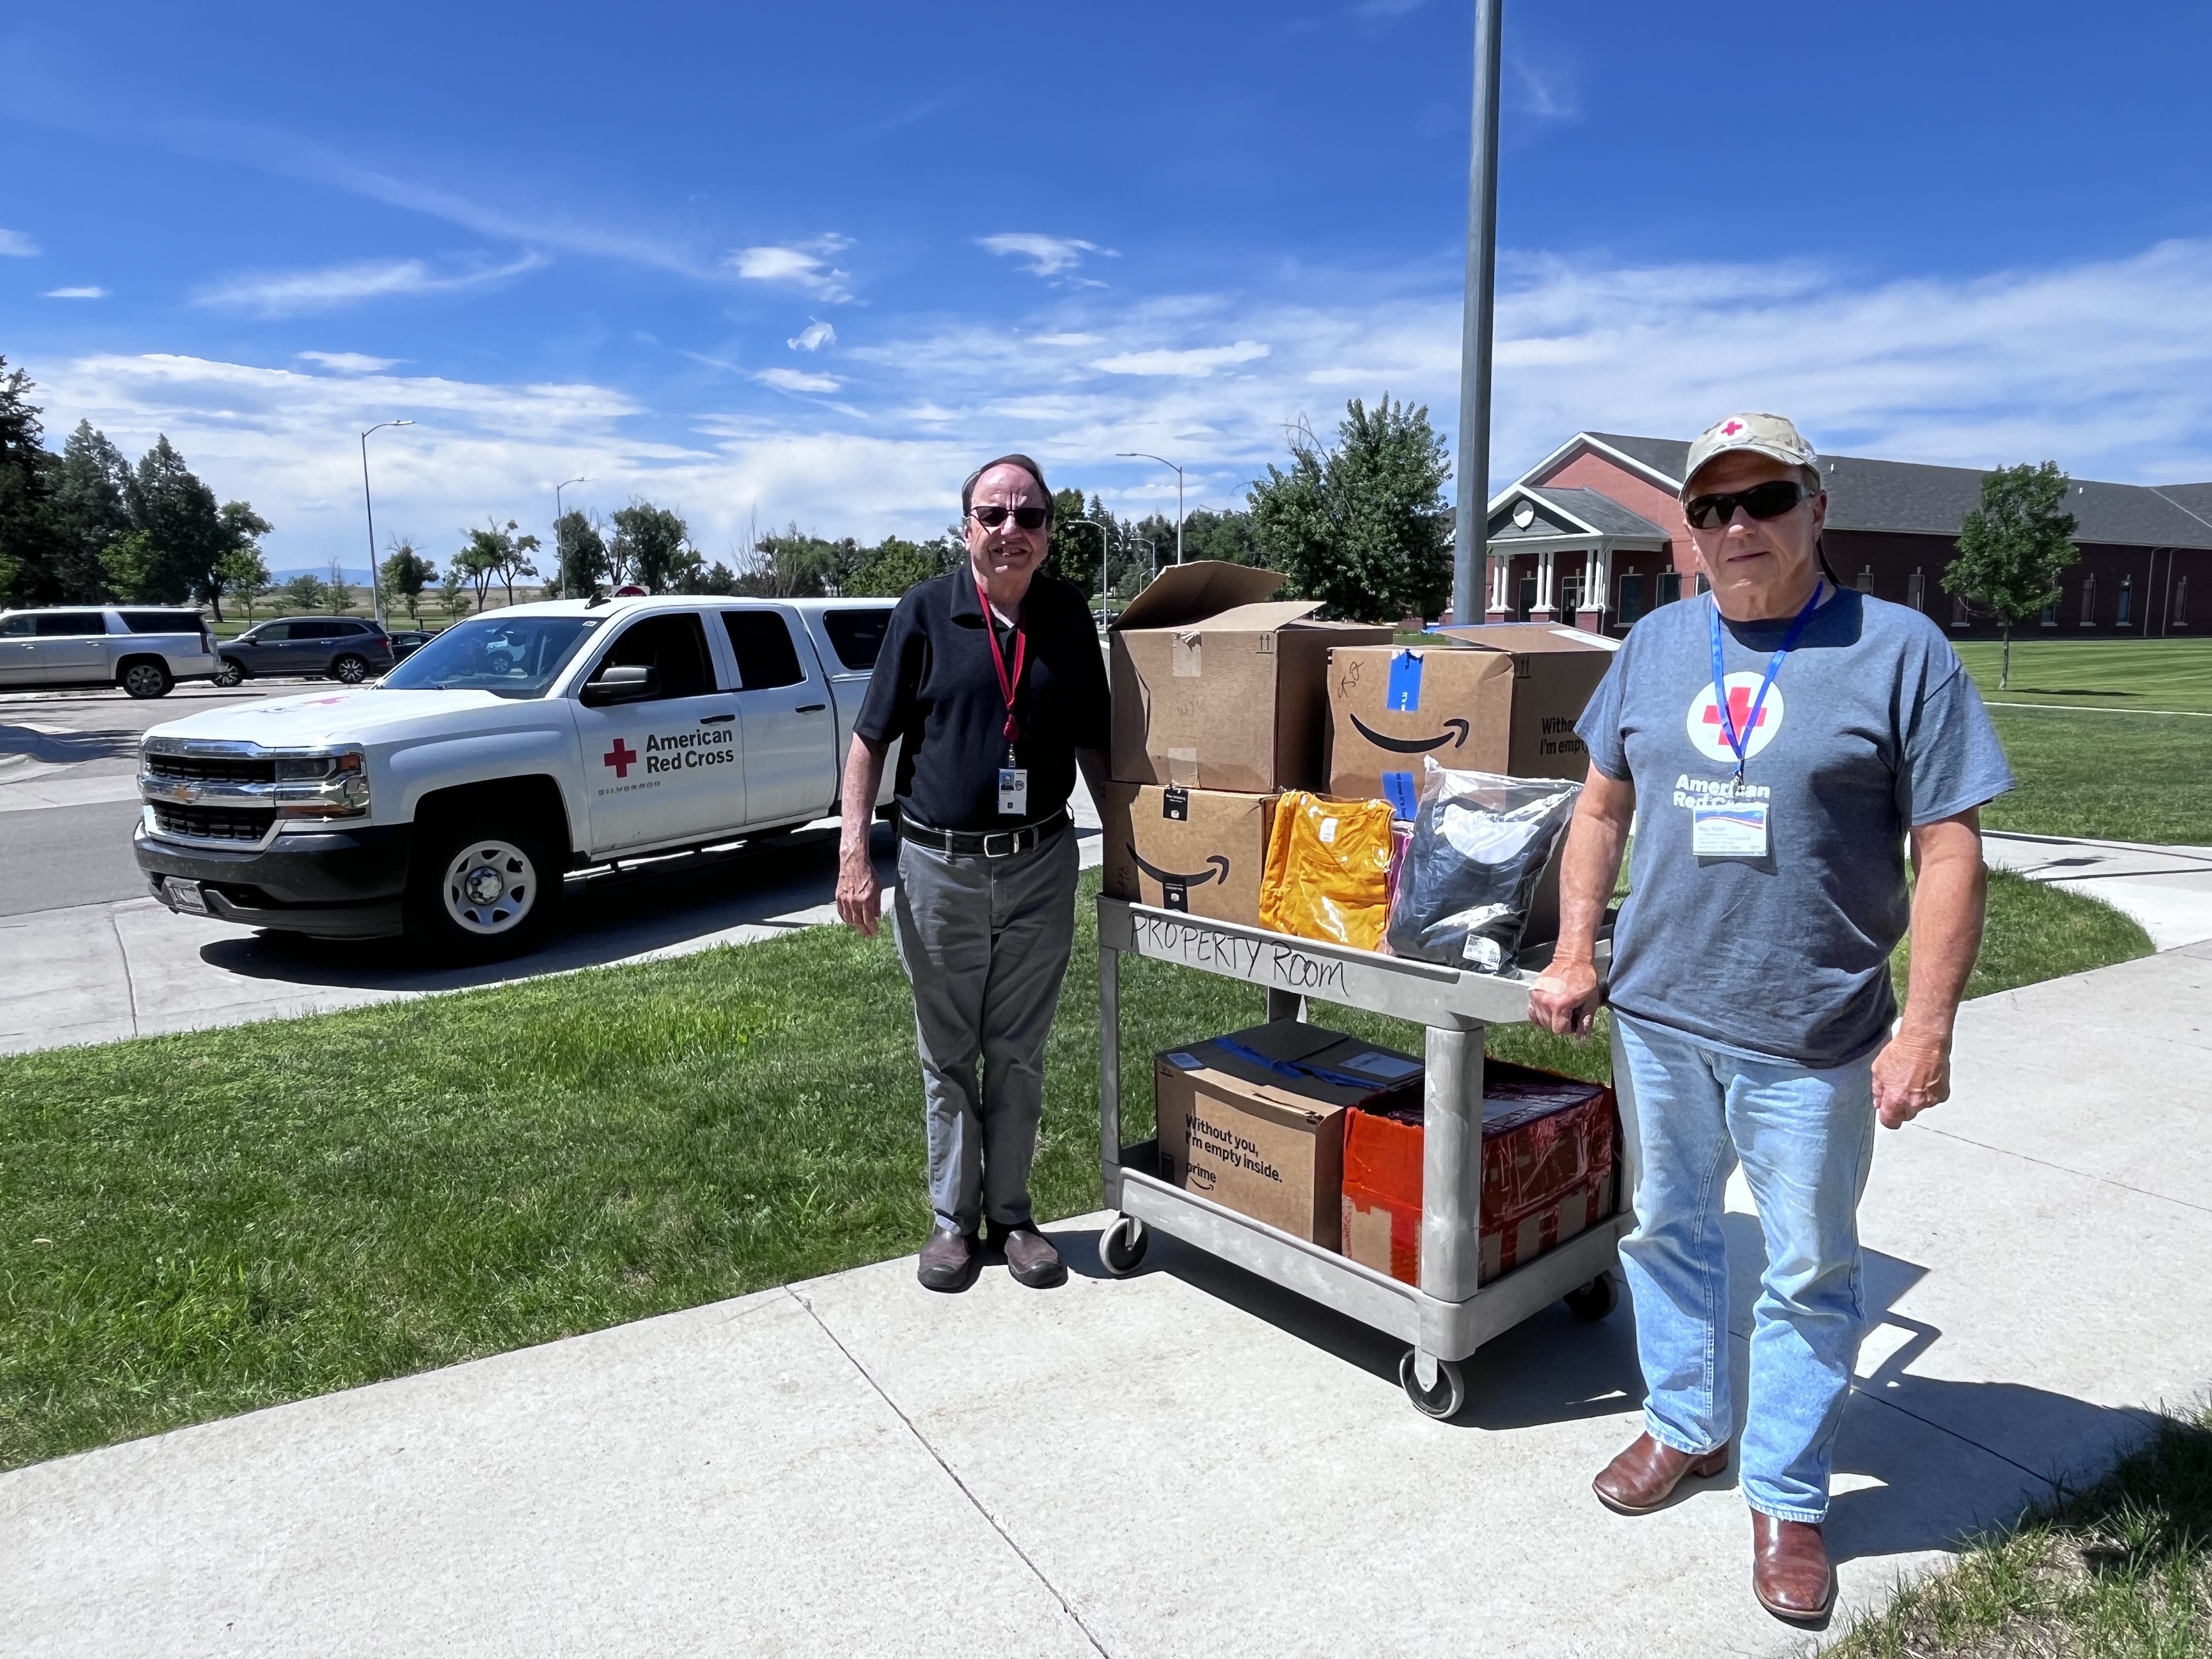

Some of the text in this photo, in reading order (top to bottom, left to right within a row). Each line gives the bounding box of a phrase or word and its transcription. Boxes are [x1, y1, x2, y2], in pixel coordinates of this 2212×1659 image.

[1542, 716, 1576, 735] Witho
[646, 729, 733, 752] American
[1540, 738, 1556, 755] I'm
[646, 749, 734, 774] Red Cross
[1128, 911, 1263, 978] PROPERTY
[1186, 1113, 1259, 1158] Without you,
[1186, 1130, 1283, 1183] I'm empty inside.
[1186, 1161, 1217, 1183] prime
